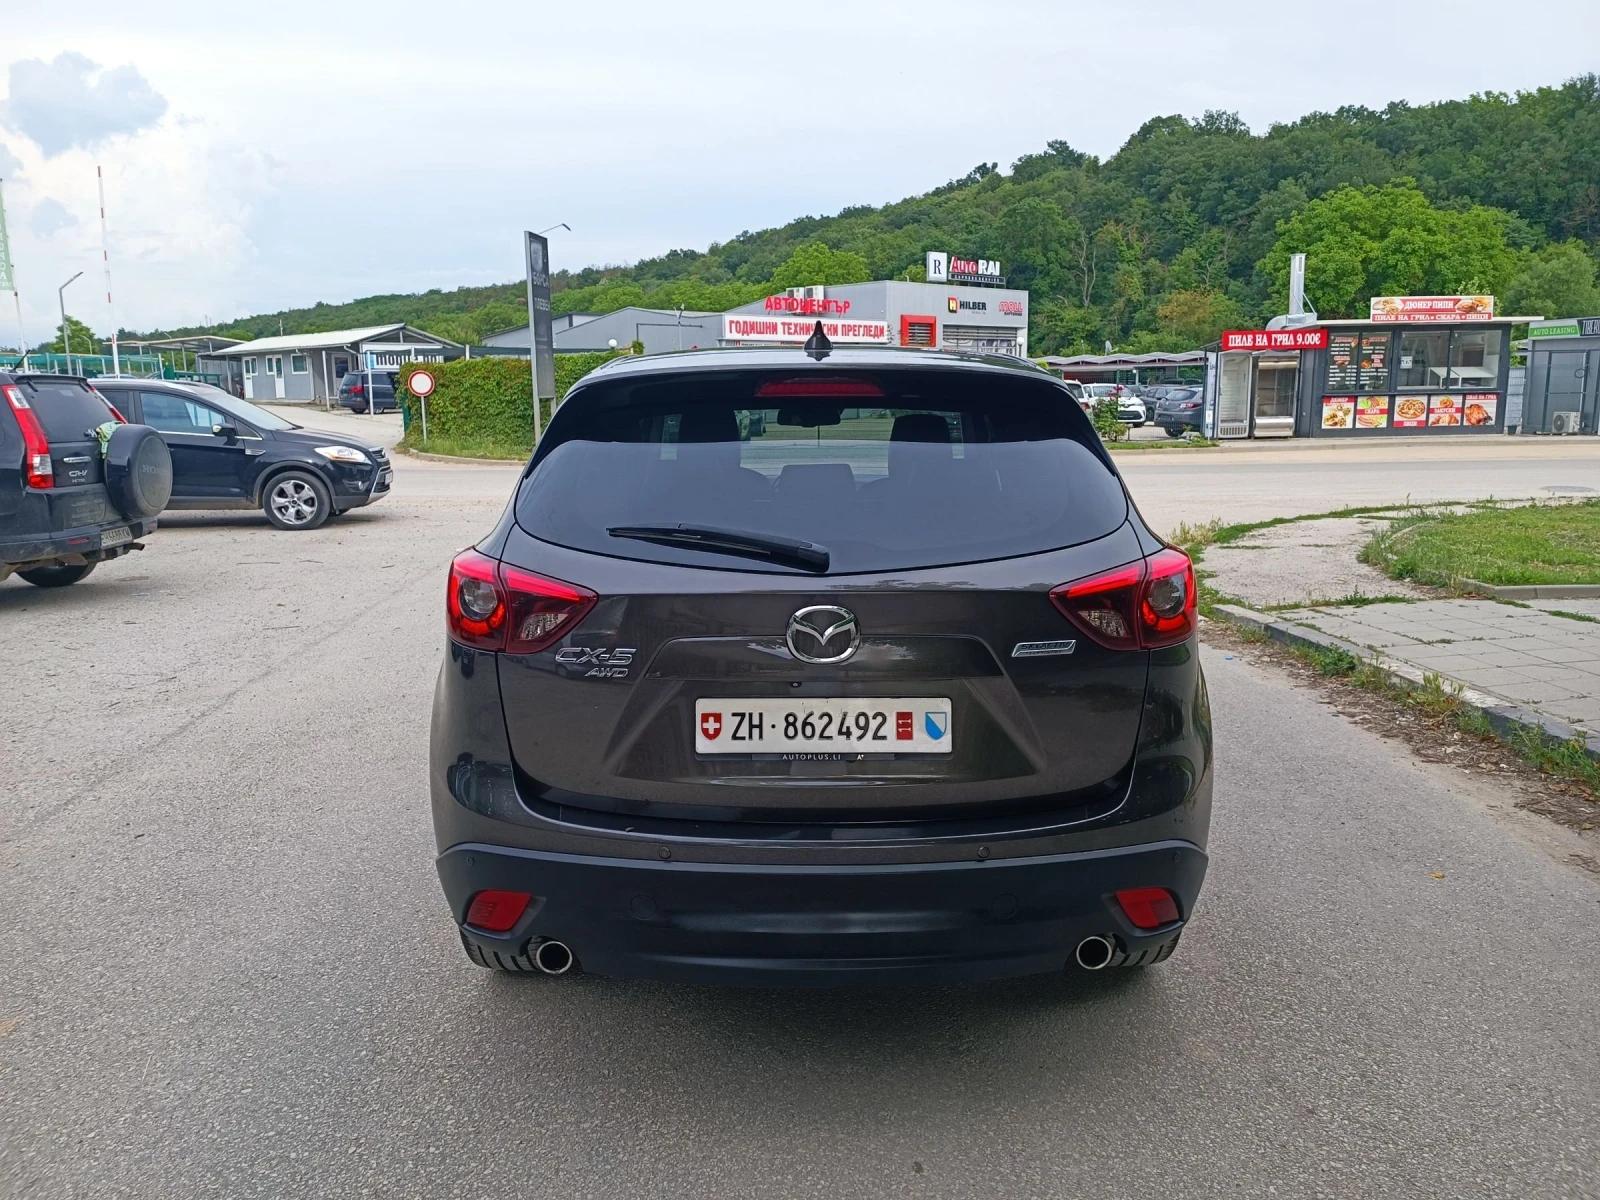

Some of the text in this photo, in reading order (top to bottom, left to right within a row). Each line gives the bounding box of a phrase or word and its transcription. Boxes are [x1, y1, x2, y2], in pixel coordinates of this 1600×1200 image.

[933, 259, 942, 275] R
[764, 296, 851, 314] АВТОЦЕНТЪР
[960, 301, 987, 311] HILBER
[1404, 301, 1431, 310] ДЮНЕР
[729, 320, 885, 339] ГОДИШНИ ТЕХНИЧСКИ ПРЕГЛЕДИ
[1533, 326, 1575, 336] AUTO LEASING
[1228, 332, 1321, 347] ПИЛЕ НА ГРИЛ 9.00€
[555, 647, 637, 665] CX-5
[584, 667, 629, 678] AWD
[782, 753, 841, 761] AUTOPLUS.LI
